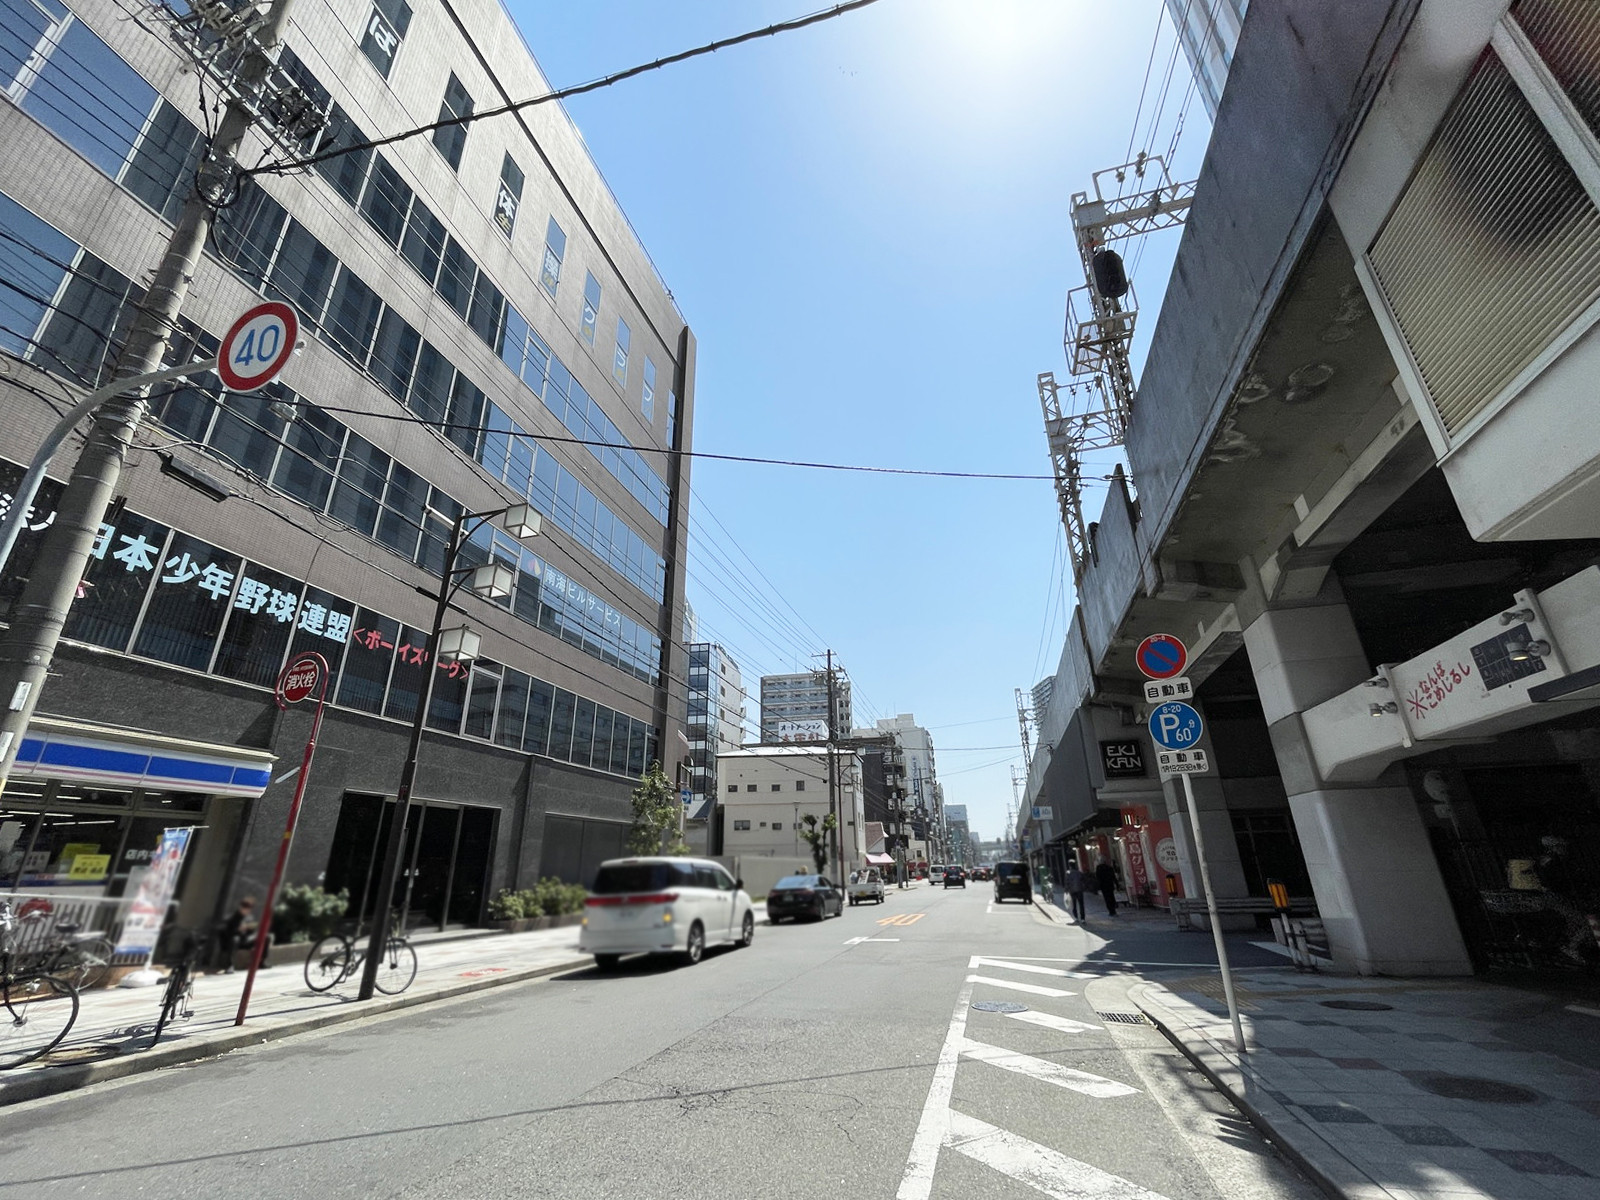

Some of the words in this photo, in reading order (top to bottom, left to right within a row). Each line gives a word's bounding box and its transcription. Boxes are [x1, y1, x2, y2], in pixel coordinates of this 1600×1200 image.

[368, 15, 397, 58] ば
[498, 189, 516, 219] 体
[235, 325, 280, 366] 40
[544, 568, 621, 628] 南海ビルサービス
[285, 671, 316, 691] 消火栓
[1418, 660, 1446, 694] なんば
[1147, 682, 1190, 698] 自動車
[1162, 705, 1182, 714] 8-20
[1159, 713, 1180, 743] P
[1107, 745, 1136, 756] EKI
[1160, 751, 1204, 764] 自動車
[1106, 757, 1142, 769] KAN
